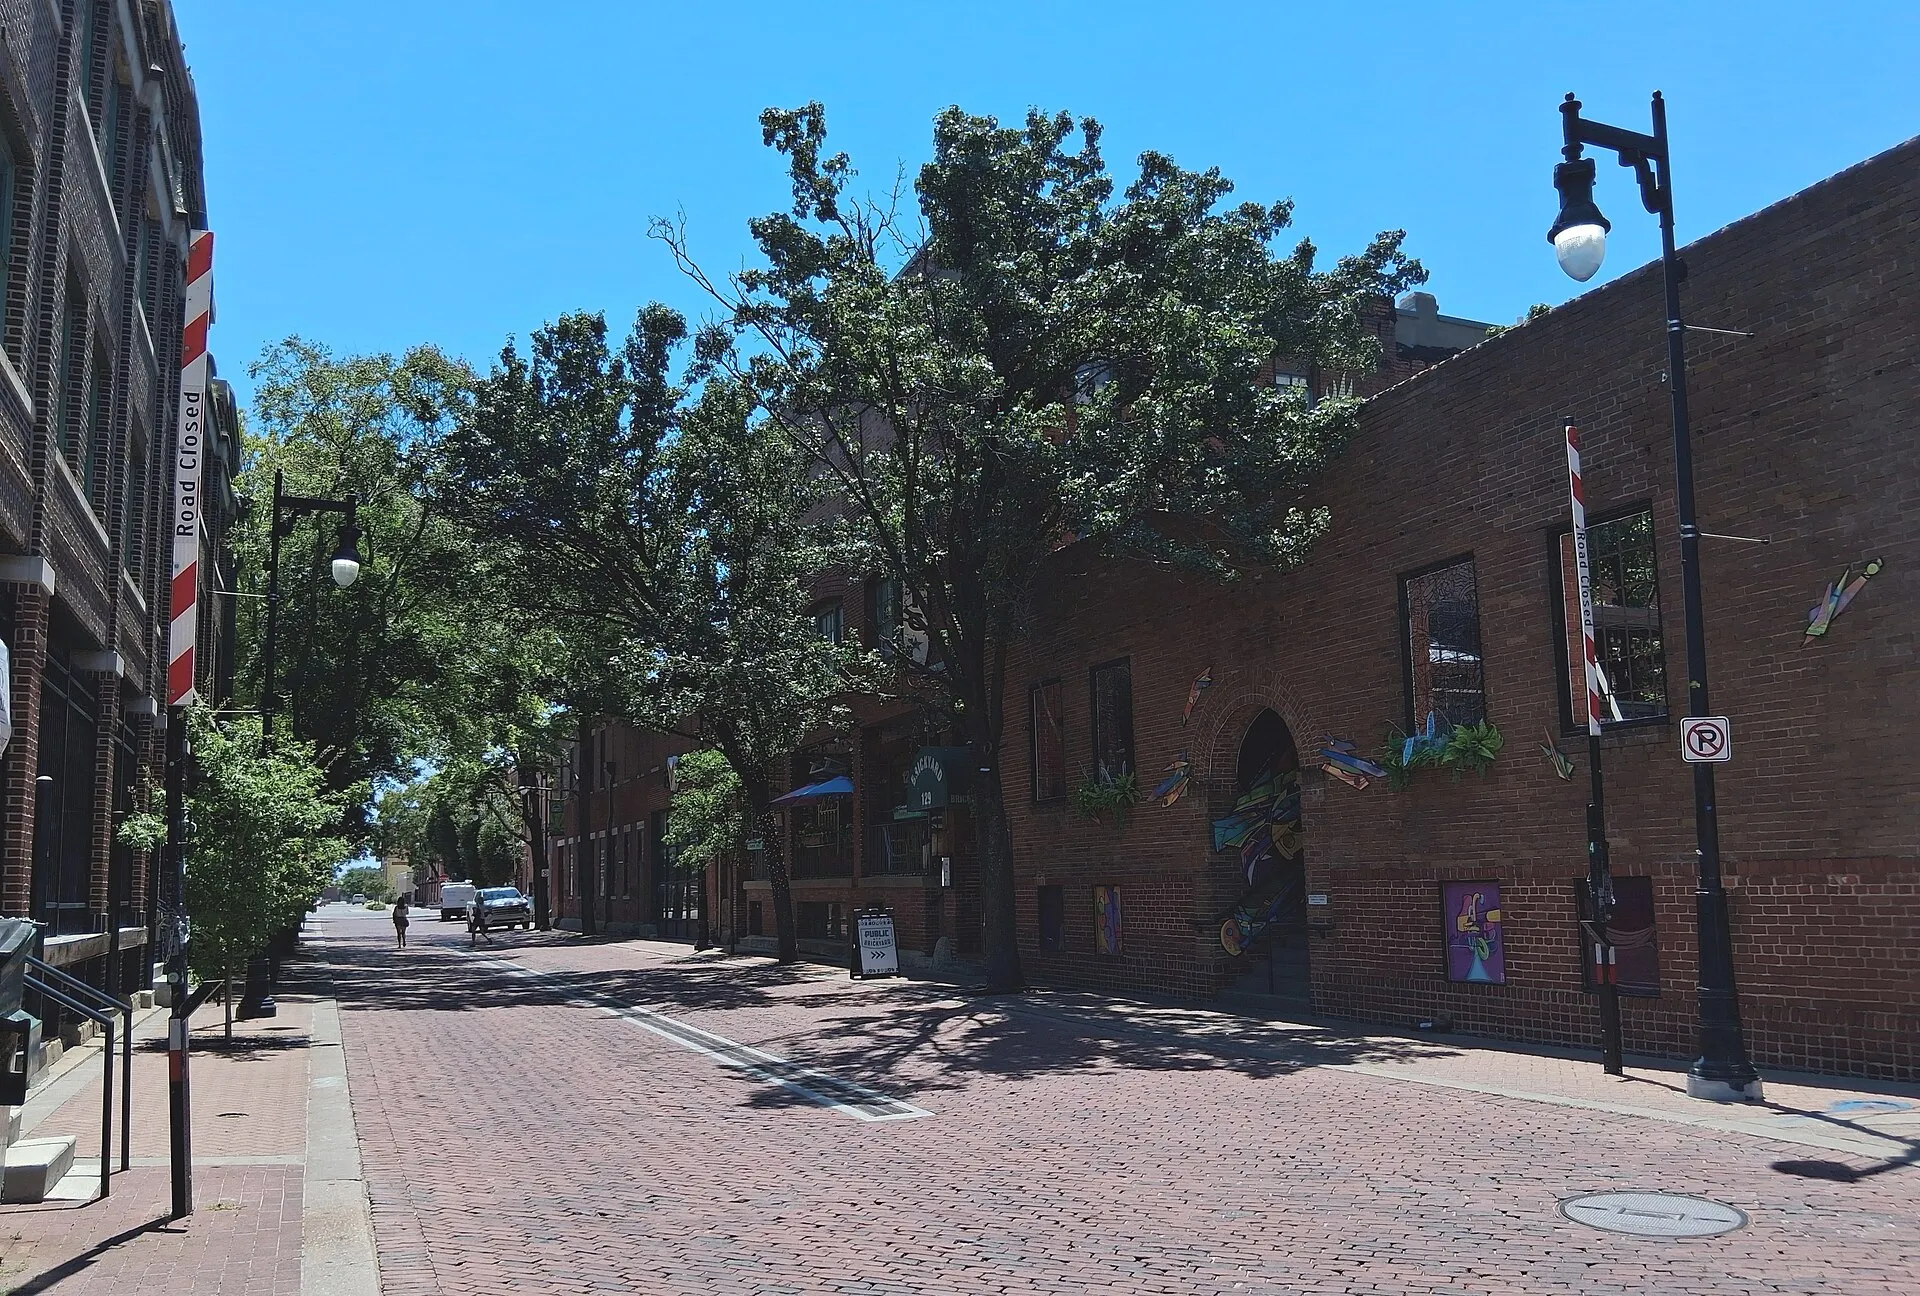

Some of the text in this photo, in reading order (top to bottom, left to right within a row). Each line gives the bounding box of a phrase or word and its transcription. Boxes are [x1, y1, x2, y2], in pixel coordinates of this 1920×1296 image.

[176, 391, 200, 536] Road Closed
[1577, 532, 1593, 627] Road Closed
[921, 791, 932, 806] 129
[864, 929, 889, 938] PUBLIC
